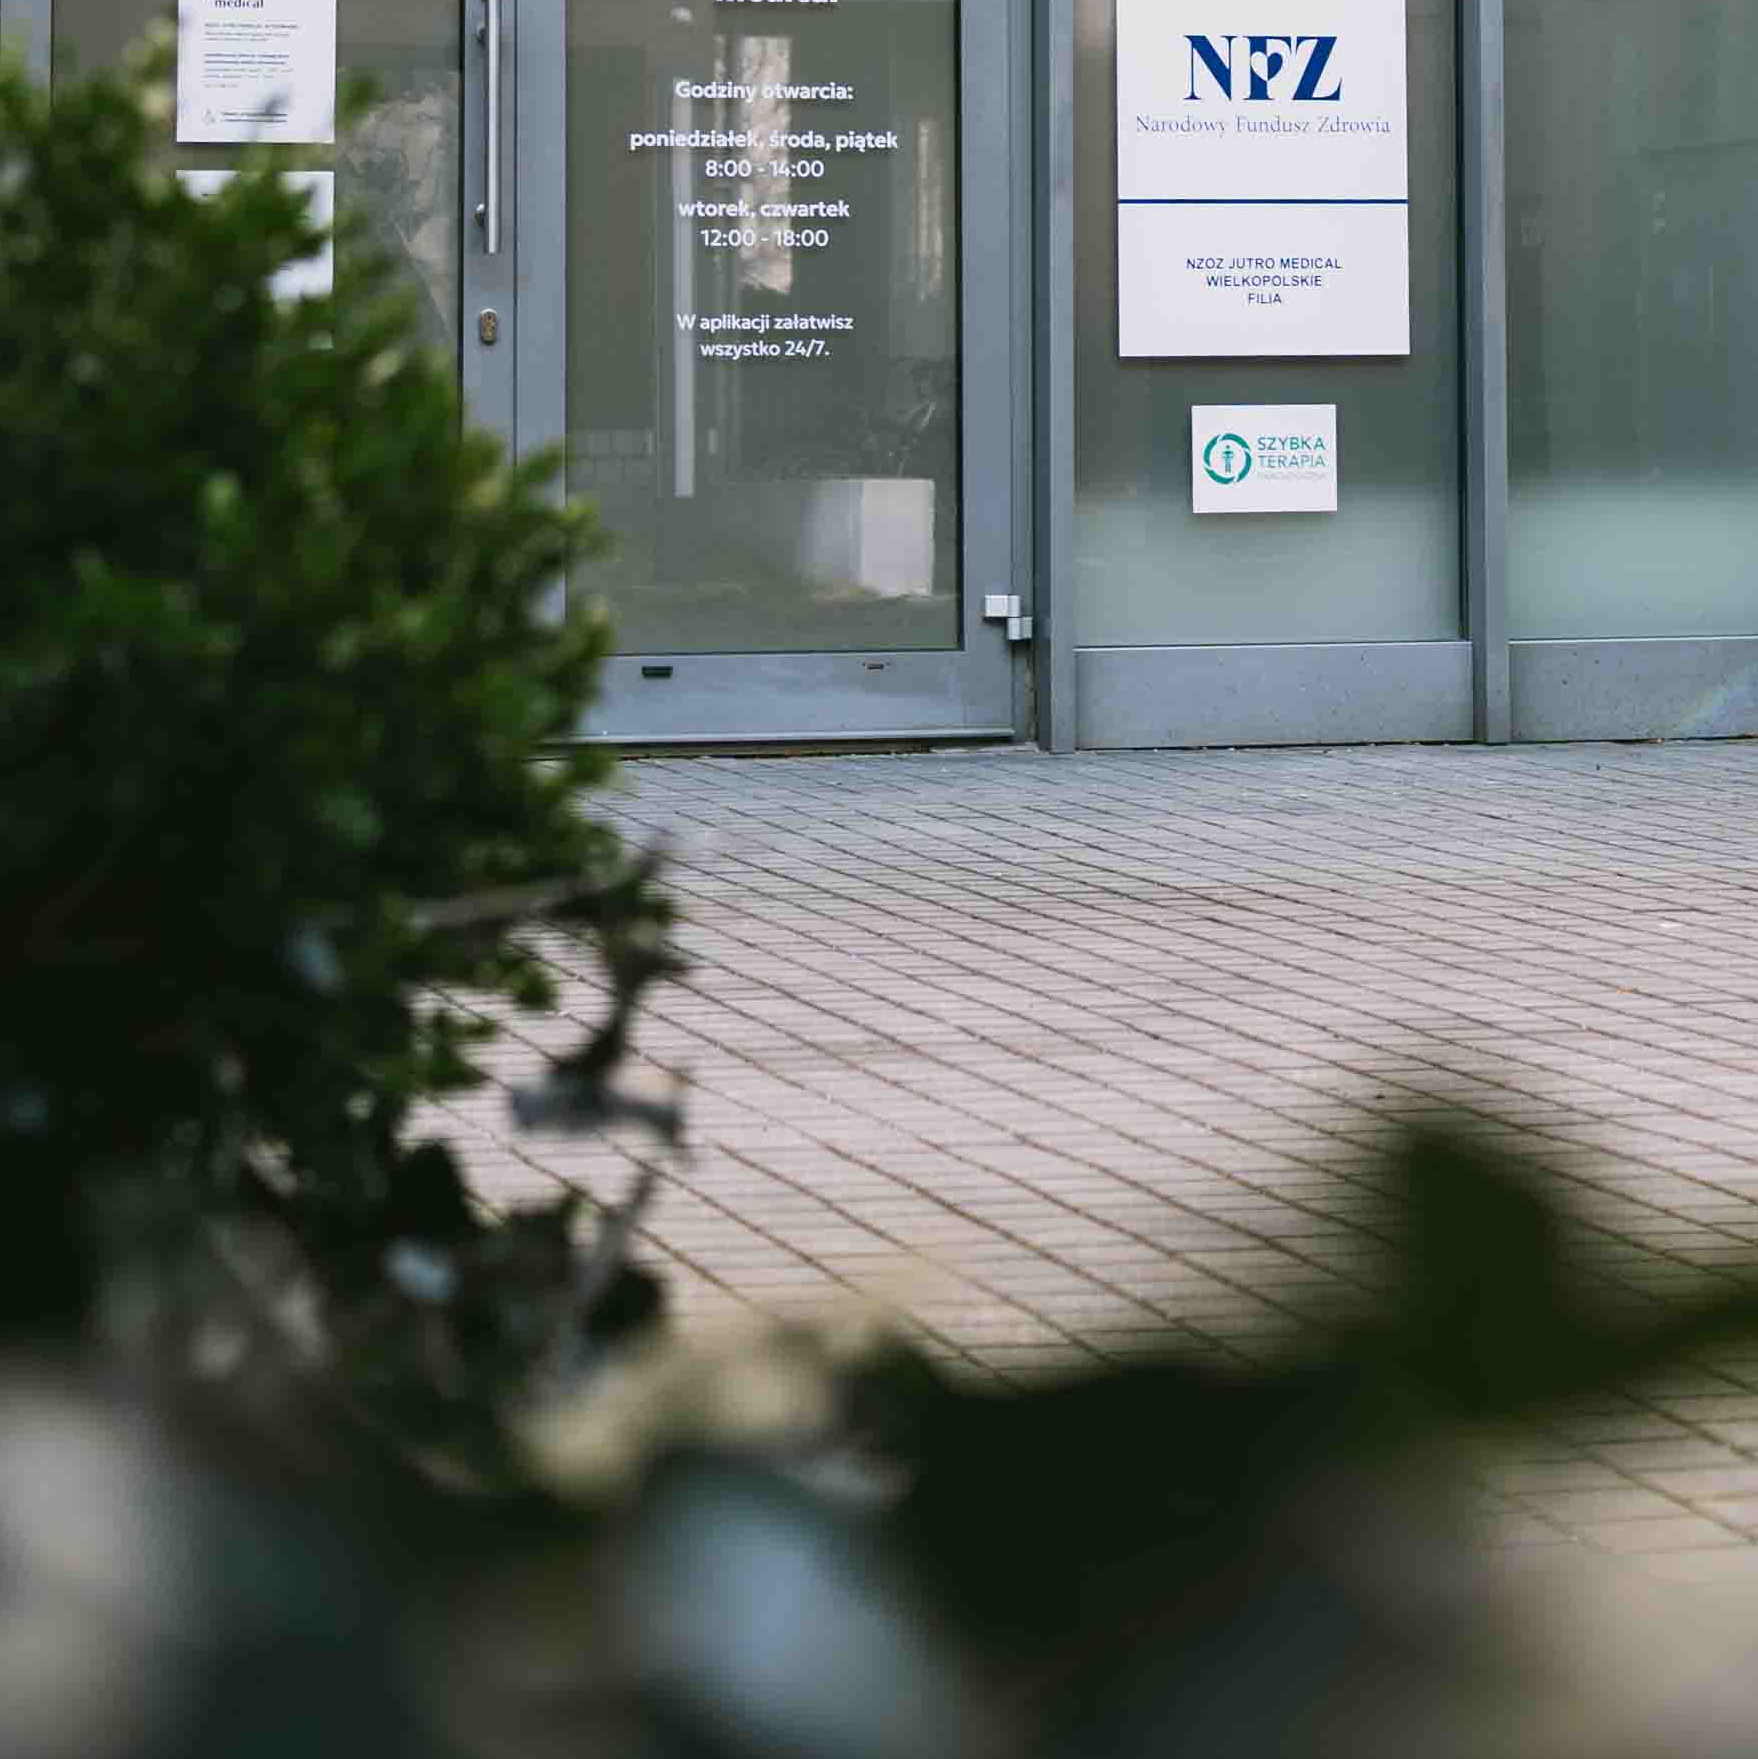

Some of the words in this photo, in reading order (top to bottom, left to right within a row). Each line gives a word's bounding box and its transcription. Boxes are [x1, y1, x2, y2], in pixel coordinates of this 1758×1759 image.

[1184, 34, 1342, 102] NFZ
[675, 81, 755, 103] Godziny
[762, 82, 853, 100] otwarcia:
[1136, 113, 1225, 139] Narodowy
[1236, 114, 1310, 134] Fundusz
[1317, 115, 1391, 133] Zdrowia
[630, 130, 761, 152] poniedziałek,
[769, 129, 830, 151] środa,
[836, 131, 898, 152] piątek
[705, 160, 751, 177] 8:00
[771, 160, 824, 178] 14:00
[678, 200, 755, 220] wtorek,
[761, 200, 849, 218] czwartek
[701, 229, 755, 247] 12:00
[774, 230, 828, 247] 18:00
[1186, 257, 1224, 270] NZOZ
[1228, 257, 1276, 270] JUTRO
[1280, 257, 1343, 270] MEDICAL
[1206, 274, 1322, 287] WIELKOPOLSKIE
[1248, 292, 1282, 305] FILIA
[676, 314, 695, 330] W
[700, 314, 769, 334] aplikacji
[774, 314, 853, 330] załatwisz
[701, 340, 780, 359] wszystko
[785, 338, 830, 357] 24/7.
[1257, 436, 1327, 451] SZYBKA
[1257, 454, 1327, 467] TERAPIA
